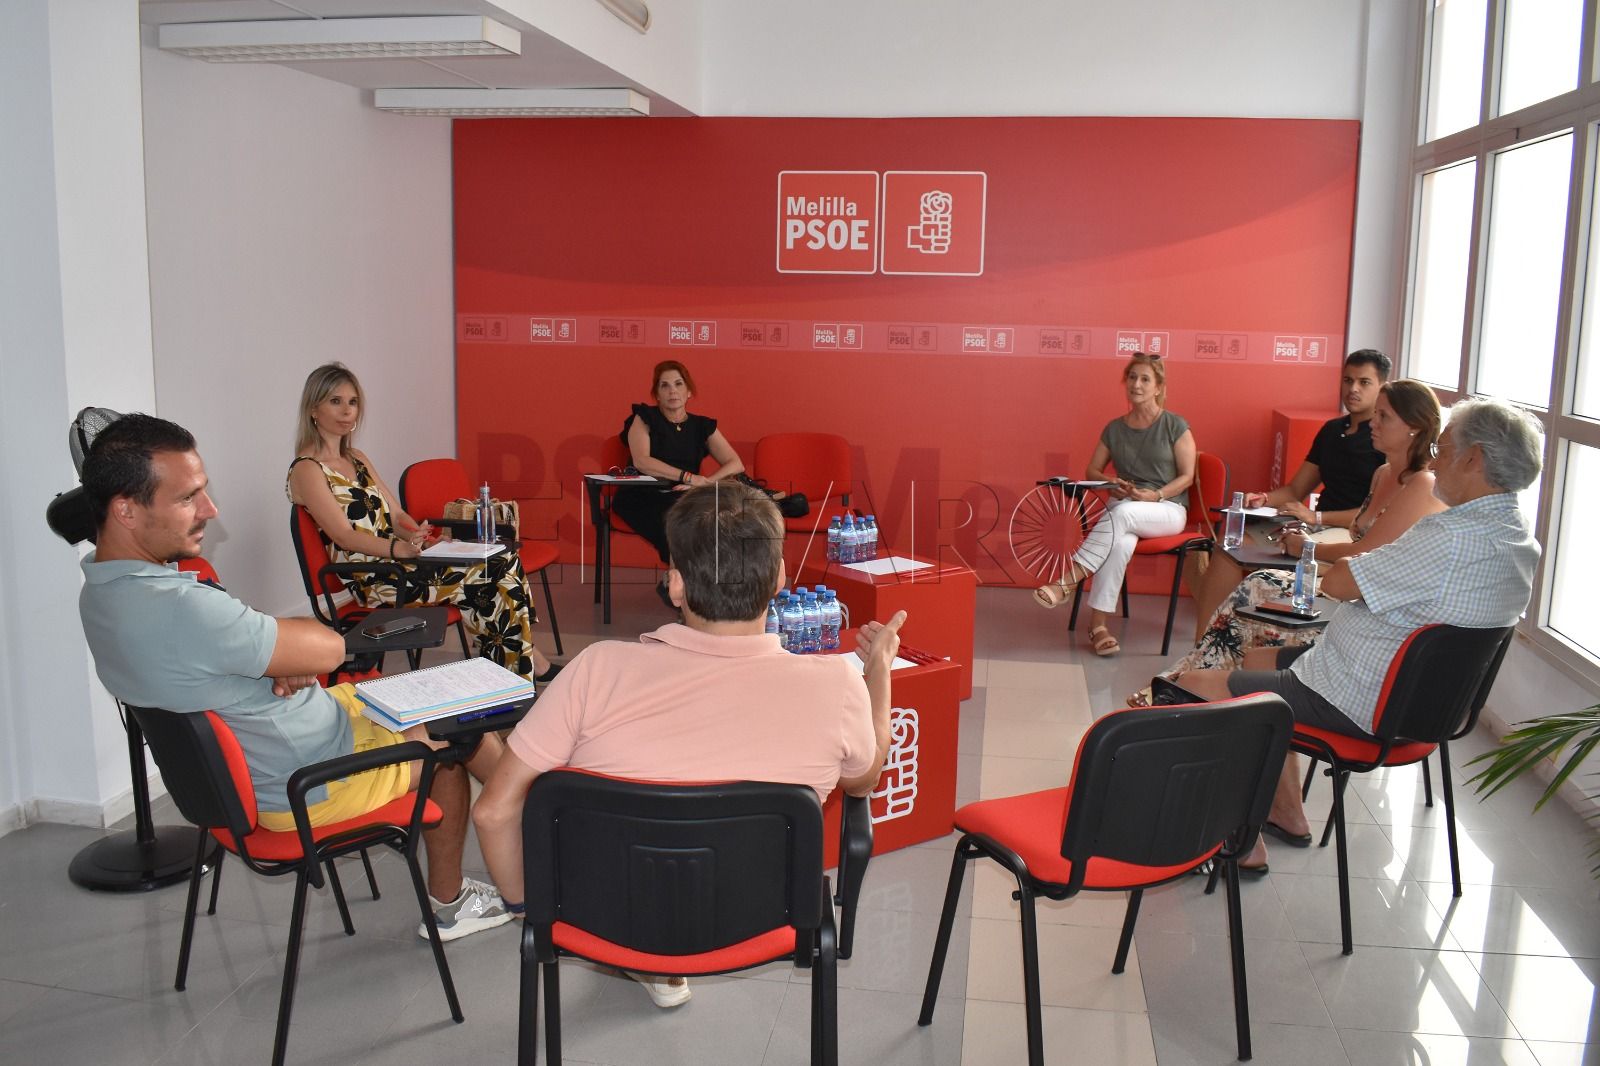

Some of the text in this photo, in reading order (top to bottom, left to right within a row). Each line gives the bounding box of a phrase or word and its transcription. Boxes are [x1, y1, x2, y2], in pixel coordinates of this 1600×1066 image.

[786, 196, 857, 216] Melilla
[786, 219, 870, 250] PSOE
[465, 327, 484, 336] PSOE
[532, 329, 552, 337] PSOE
[601, 330, 620, 338] PSOE
[671, 331, 691, 340] PSOE
[742, 333, 762, 341] PSOE
[815, 335, 836, 344] PSOE
[889, 336, 910, 345] PSOE
[965, 338, 986, 347] PSOE
[1041, 340, 1063, 349] PSOE
[1119, 342, 1140, 352] PSOE
[1197, 345, 1219, 354] PSOE
[1276, 347, 1298, 357] PSOE
